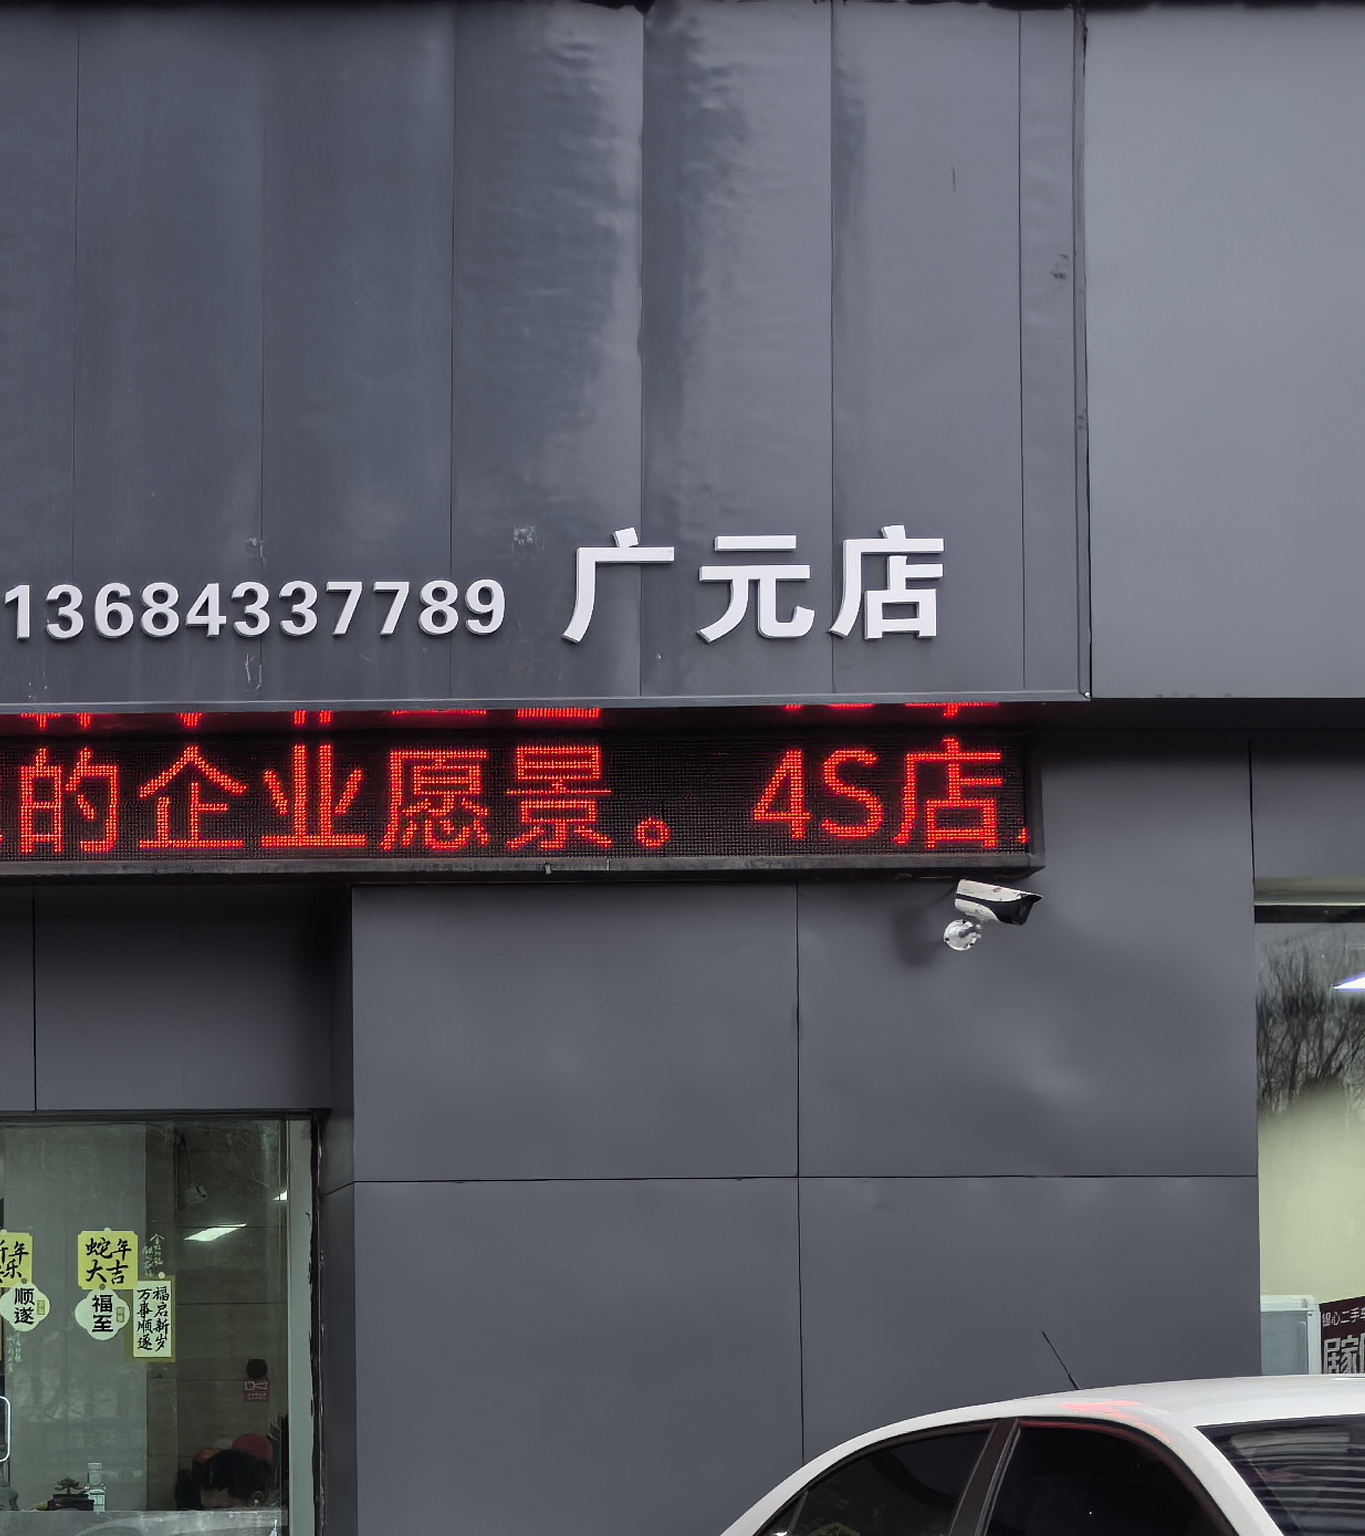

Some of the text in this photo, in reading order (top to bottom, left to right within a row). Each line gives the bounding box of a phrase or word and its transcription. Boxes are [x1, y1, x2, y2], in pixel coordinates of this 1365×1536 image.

[562, 525, 944, 643] 广元店
[85, 1237, 131, 1261] 蛇年
[86, 1259, 129, 1284] 大吉
[14, 1287, 35, 1325] 顺遂
[92, 1294, 114, 1333] 福至
